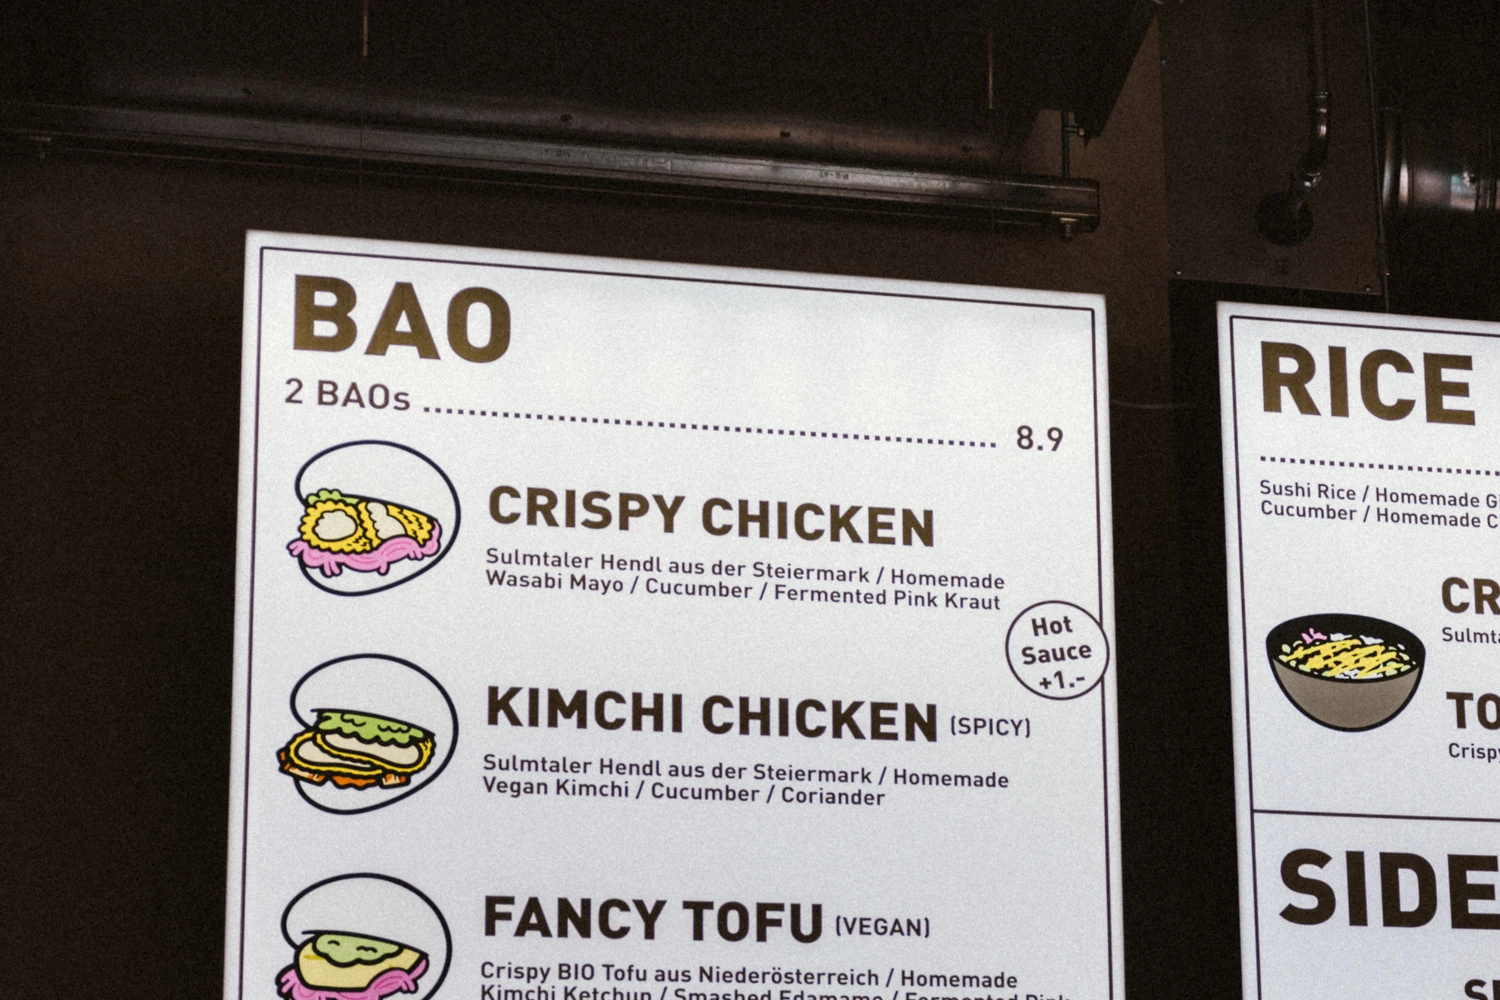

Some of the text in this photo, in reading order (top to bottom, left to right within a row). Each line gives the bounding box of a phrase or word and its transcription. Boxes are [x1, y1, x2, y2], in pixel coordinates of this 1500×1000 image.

[292, 273, 512, 364] BAO
[1260, 340, 1476, 426] RICE
[284, 377, 1064, 452] 2 BAOs 8.9
[1259, 478, 1312, 499] Sushi
[1316, 482, 1357, 502] Rice
[1375, 486, 1481, 509] Homemade
[1260, 498, 1358, 521] Cucumber
[1375, 506, 1482, 529] Homemade
[488, 484, 935, 548] CRISPY CHICKEN
[485, 546, 1006, 590] Sulmtaler Hendl aus der Steiermark Homemade
[485, 568, 1001, 611] Wasabi Mayo Cucumber Fermented Pink Kraut
[1030, 615, 1074, 638] Hot
[1020, 643, 1093, 666] Sauce
[1038, 669, 1086, 690] +1.-
[486, 685, 1031, 743] KIMCHI CHICKEN (SPICY)
[482, 775, 886, 807] Vegan Kimchi Cucumber Coriander
[484, 894, 931, 945] FANCY TOFU (VEGAN)
[480, 960, 1019, 989] Crispy BIO Tofu aus Niederösterreich Homemade
